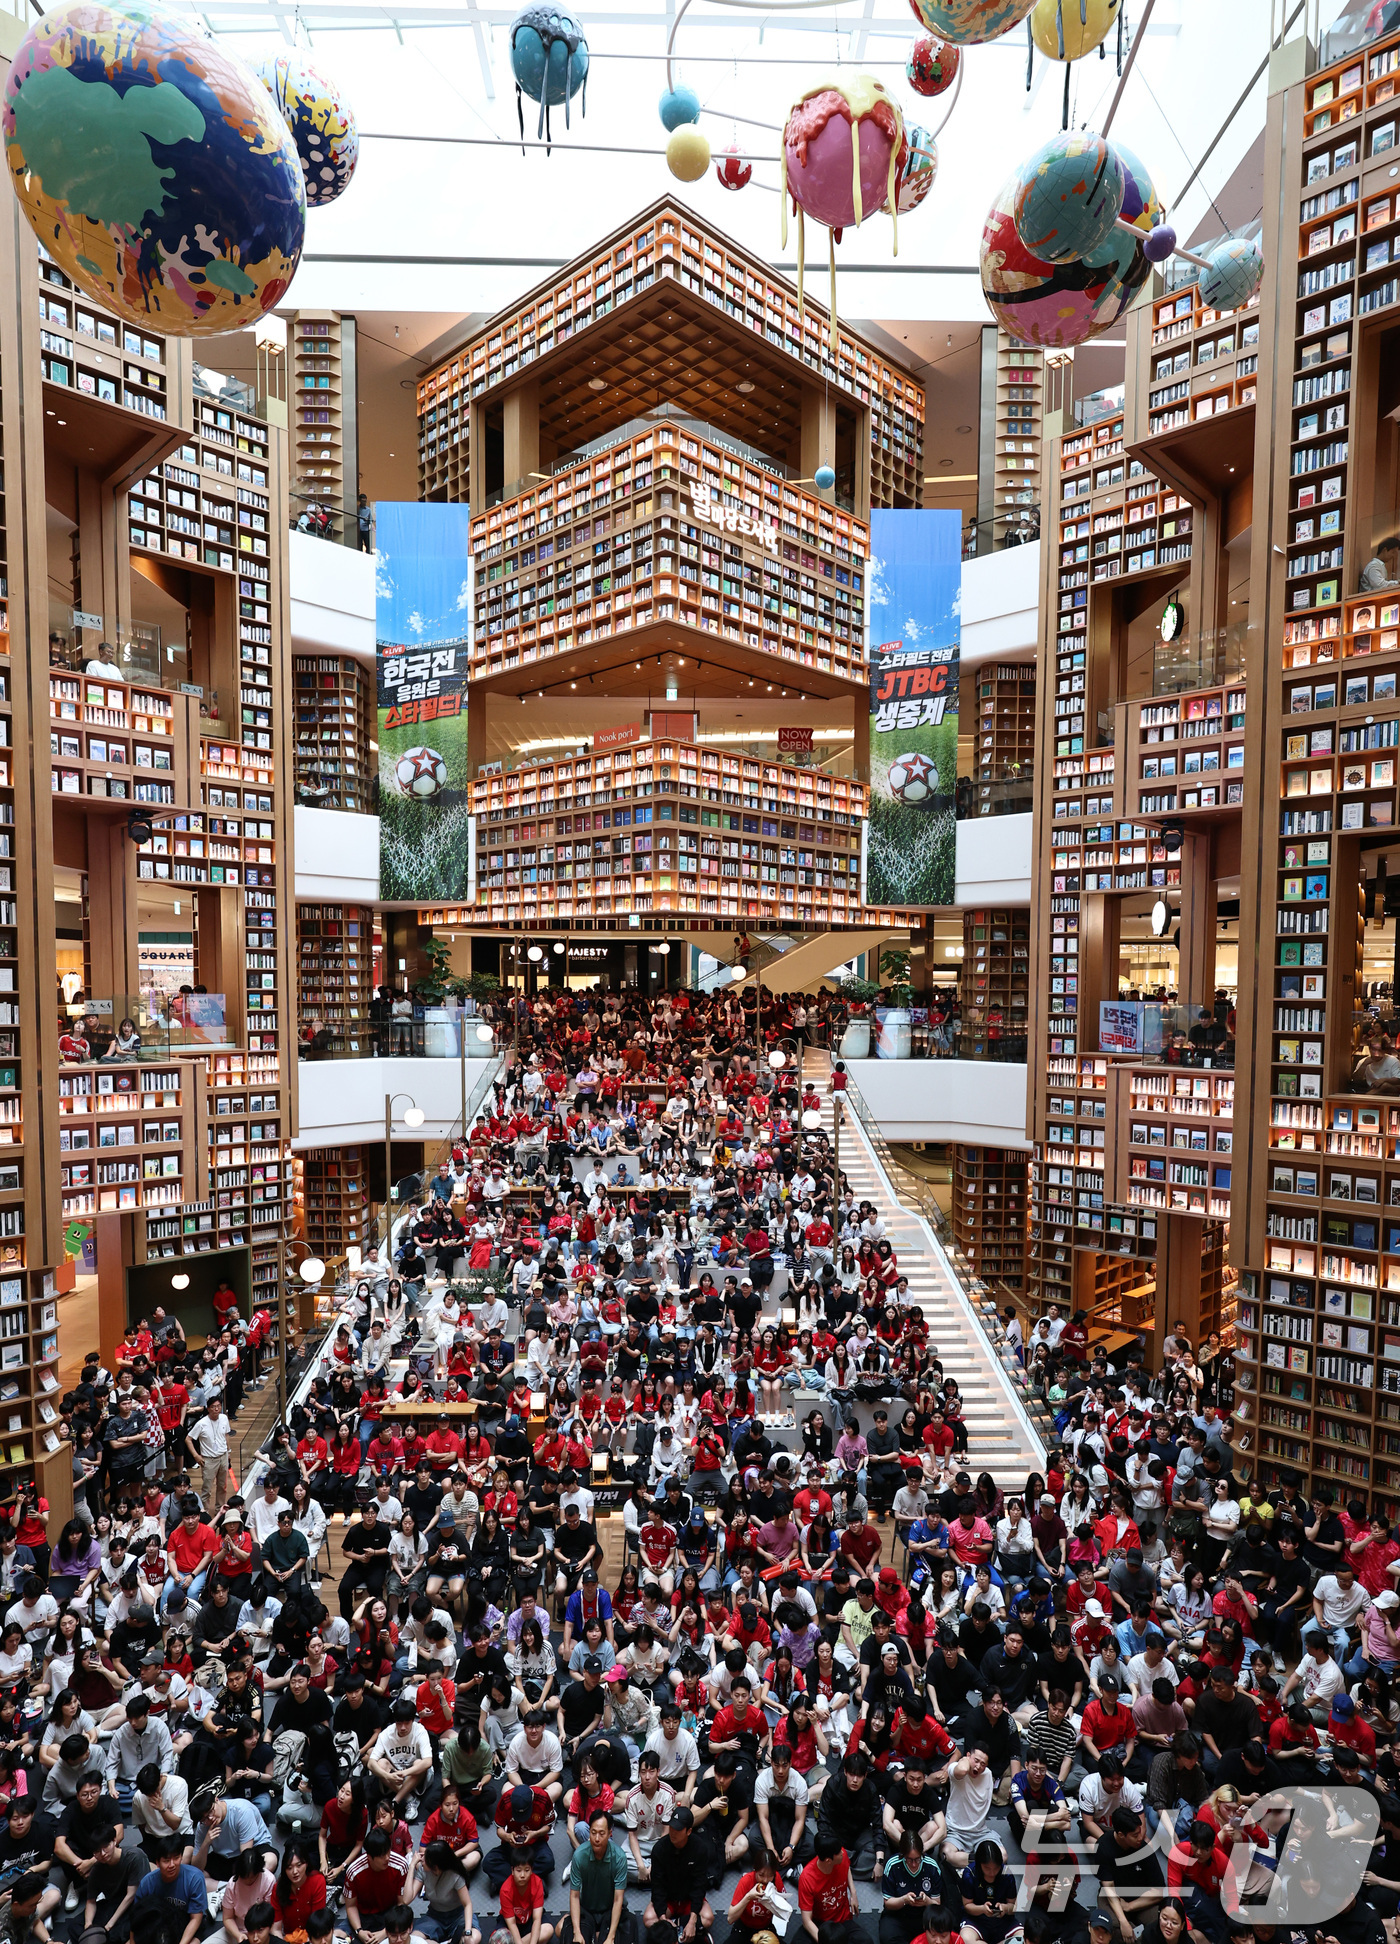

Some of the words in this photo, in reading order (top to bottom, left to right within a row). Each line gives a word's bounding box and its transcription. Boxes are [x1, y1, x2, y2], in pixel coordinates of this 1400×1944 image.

[689, 480, 778, 553] 별마당도서관
[388, 645, 402, 656] LIVE
[885, 642, 901, 651] LIVE
[383, 649, 459, 688] 한국전
[878, 651, 931, 670] 스타필드
[876, 665, 949, 700] JTBC
[396, 679, 441, 703] 응원은
[383, 694, 461, 730] 스타필드!
[874, 696, 948, 734] 생중계
[599, 731, 617, 744] Nook
[617, 728, 633, 742] port
[781, 730, 811, 740] NOW
[780, 741, 810, 750] OPEN
[141, 952, 193, 960] SQUARE
[1180, 1605, 1200, 1620] AIA
[389, 1746, 416, 1758] SEOUL
